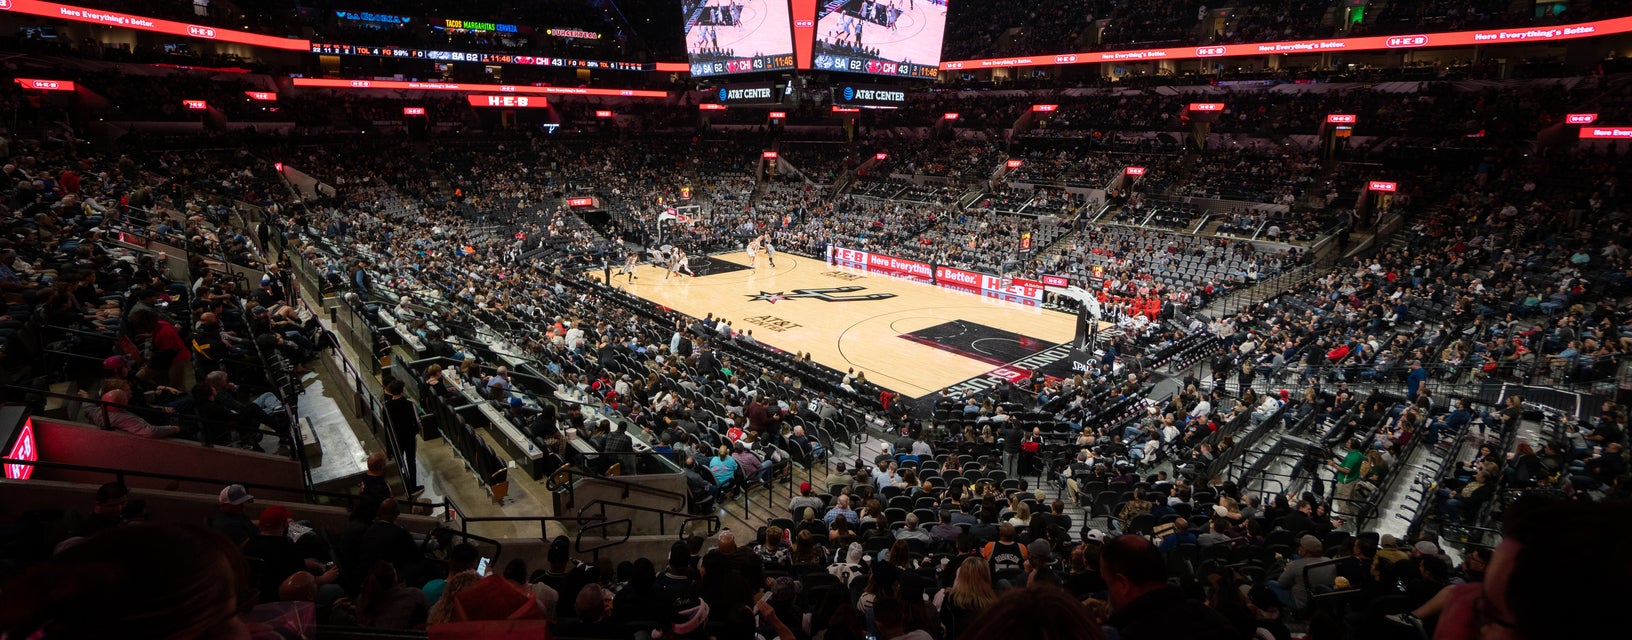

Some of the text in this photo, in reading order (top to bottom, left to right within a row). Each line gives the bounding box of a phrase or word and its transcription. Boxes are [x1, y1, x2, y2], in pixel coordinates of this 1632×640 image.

[60, 7, 154, 28] Here Everything's Better.
[445, 19, 518, 33] TACOS MARGARITAS CERVEZA
[1474, 25, 1595, 41] Here Everything's Better.
[356, 47, 370, 55] TOL
[1276, 42, 1318, 51] Everything's
[1320, 41, 1345, 49] Better.
[451, 52, 465, 60] SA
[466, 53, 478, 61] 62
[535, 57, 549, 65] CHI
[551, 58, 563, 66] 43
[1115, 51, 1146, 60] Everything's
[702, 64, 712, 74] SA
[714, 63, 723, 72] 62
[739, 61, 751, 70] CHI
[753, 59, 763, 69] 43
[774, 56, 793, 67] 11:46
[834, 59, 846, 69] SA
[850, 59, 861, 70] 62
[882, 62, 897, 73] CHI
[898, 64, 908, 74] 43
[920, 67, 938, 77] 11:46
[727, 87, 771, 100] AT&T CENTER
[854, 90, 905, 102] AT&T CENTER
[488, 95, 529, 107] H-E-B
[870, 254, 890, 267] Here
[753, 314, 804, 329] AT&T
